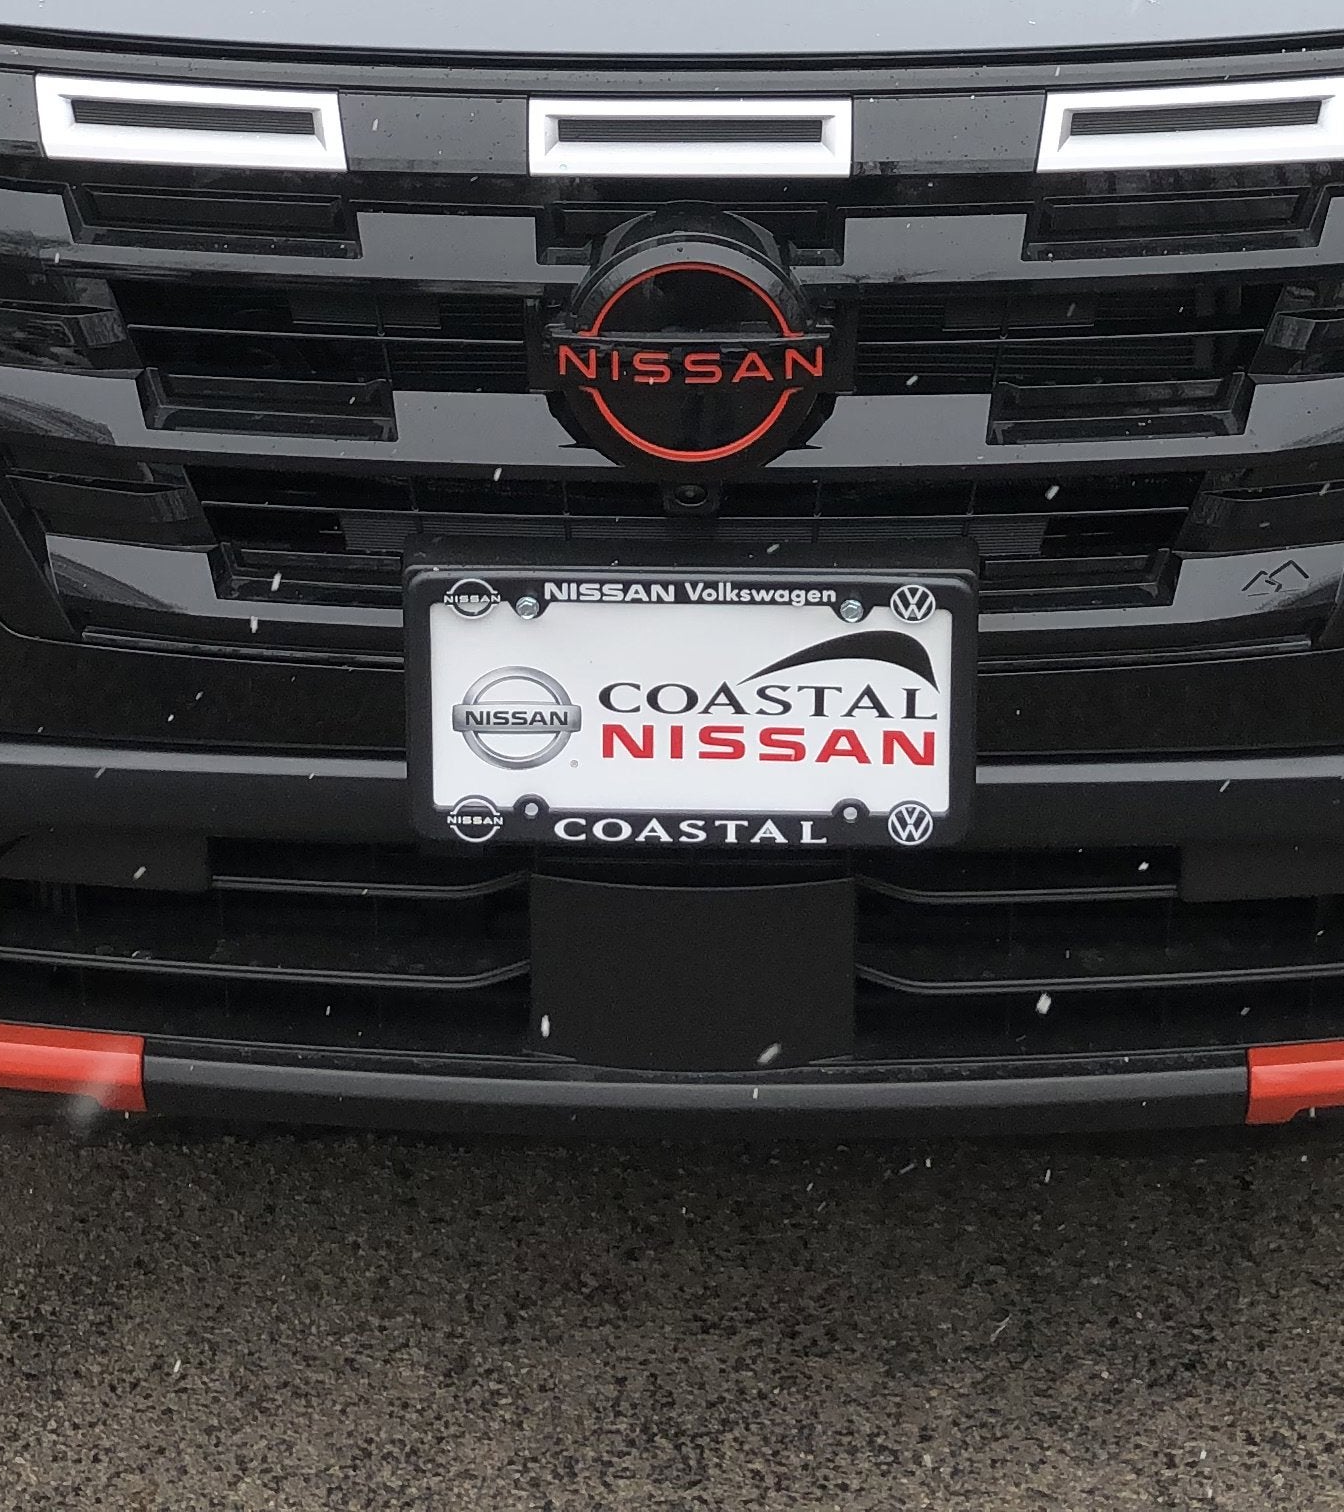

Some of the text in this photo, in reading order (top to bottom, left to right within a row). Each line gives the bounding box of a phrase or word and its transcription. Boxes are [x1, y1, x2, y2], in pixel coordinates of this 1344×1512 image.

[558, 345, 825, 384] NISSAN
[443, 594, 501, 604] NISSAN
[544, 581, 837, 607] NISSAN Volkswagen
[598, 680, 938, 720] COASTAL
[465, 710, 569, 726] NISSAN
[602, 723, 936, 767] NISSAN
[446, 815, 504, 826] NISSAN
[553, 817, 827, 844] COASTAL
